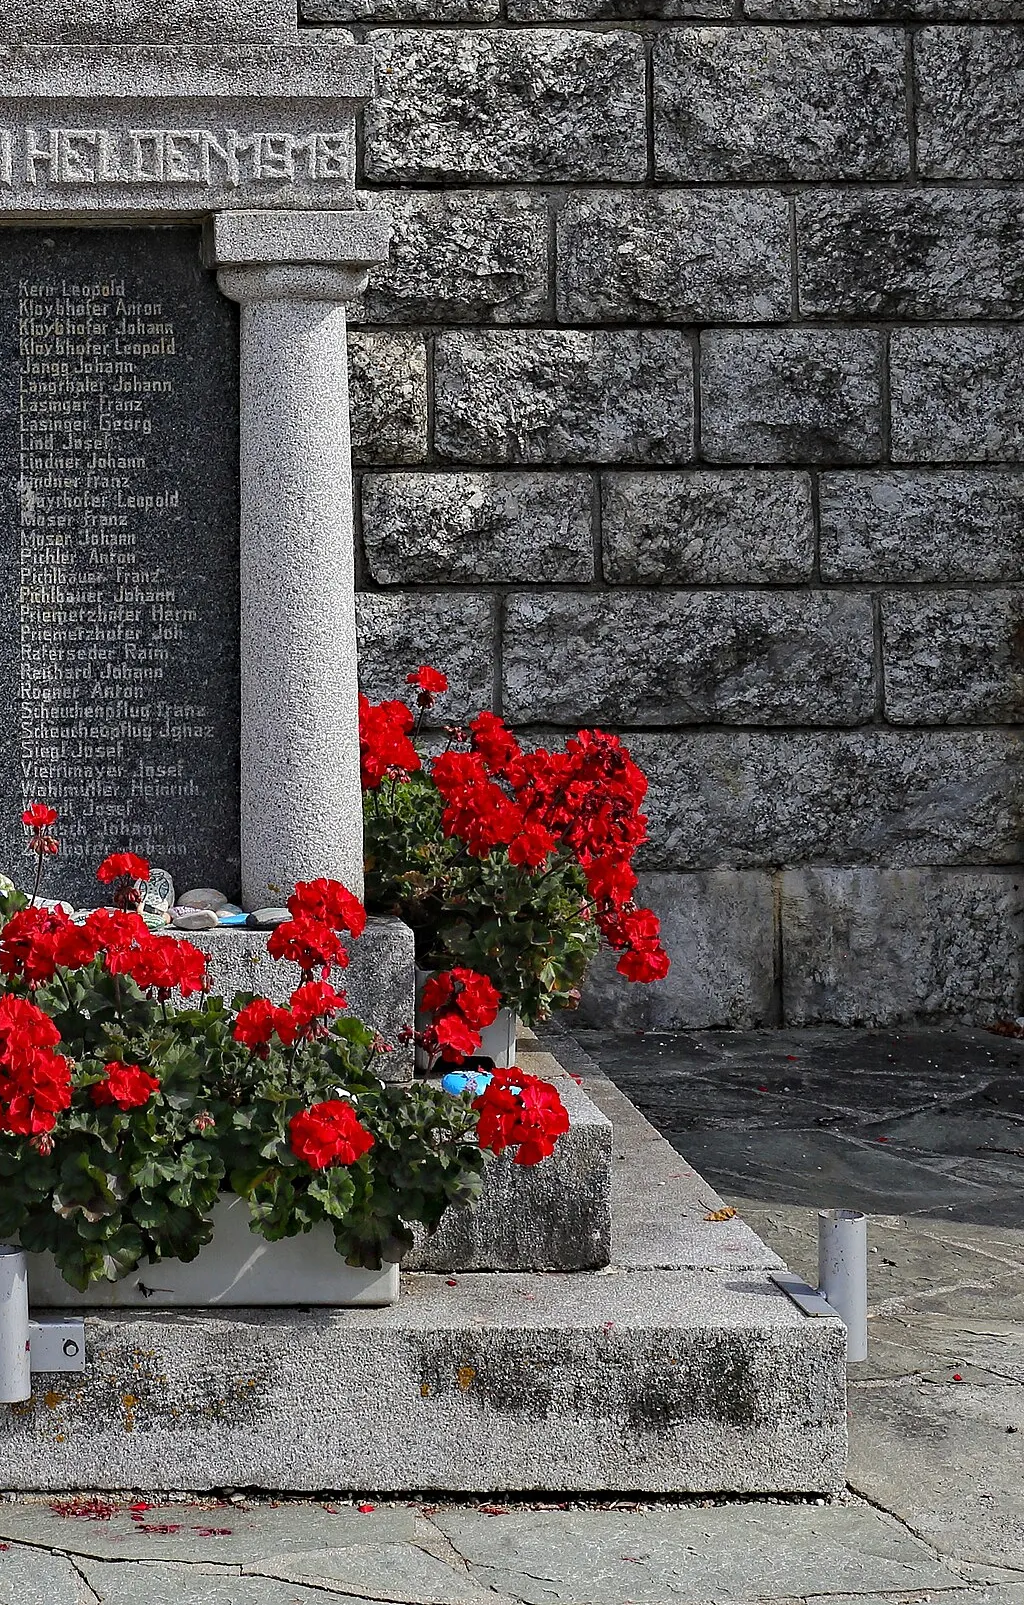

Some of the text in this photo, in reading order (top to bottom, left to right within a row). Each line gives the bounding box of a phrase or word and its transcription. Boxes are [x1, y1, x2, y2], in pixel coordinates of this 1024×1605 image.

[23, 129, 238, 186] HELDEN
[239, 132, 350, 181] 1918
[18, 280, 125, 299] Kern Leopold
[116, 299, 162, 316] Anton
[115, 318, 174, 335] Johann
[115, 338, 176, 357] Leopold
[74, 357, 134, 374] Johann
[113, 375, 173, 392] Johann
[19, 394, 143, 414] Lasinger Franz
[19, 414, 153, 434] Lasinger Georg
[20, 433, 111, 450] Lind Josef
[20, 452, 146, 468] Lindner Johann
[86, 471, 131, 488] Franz
[118, 490, 179, 509] Leopold
[84, 509, 129, 526] Franz
[20, 529, 136, 546] Moser Johann
[20, 547, 136, 564] Pichler Anton
[116, 567, 160, 584] Franz
[113, 586, 176, 603] Johann
[99, 662, 164, 679] Johann
[91, 682, 144, 698] Anton
[158, 702, 206, 719] Franz
[71, 741, 125, 758] Josef
[133, 761, 185, 778] Josef
[82, 799, 133, 816] Josef
